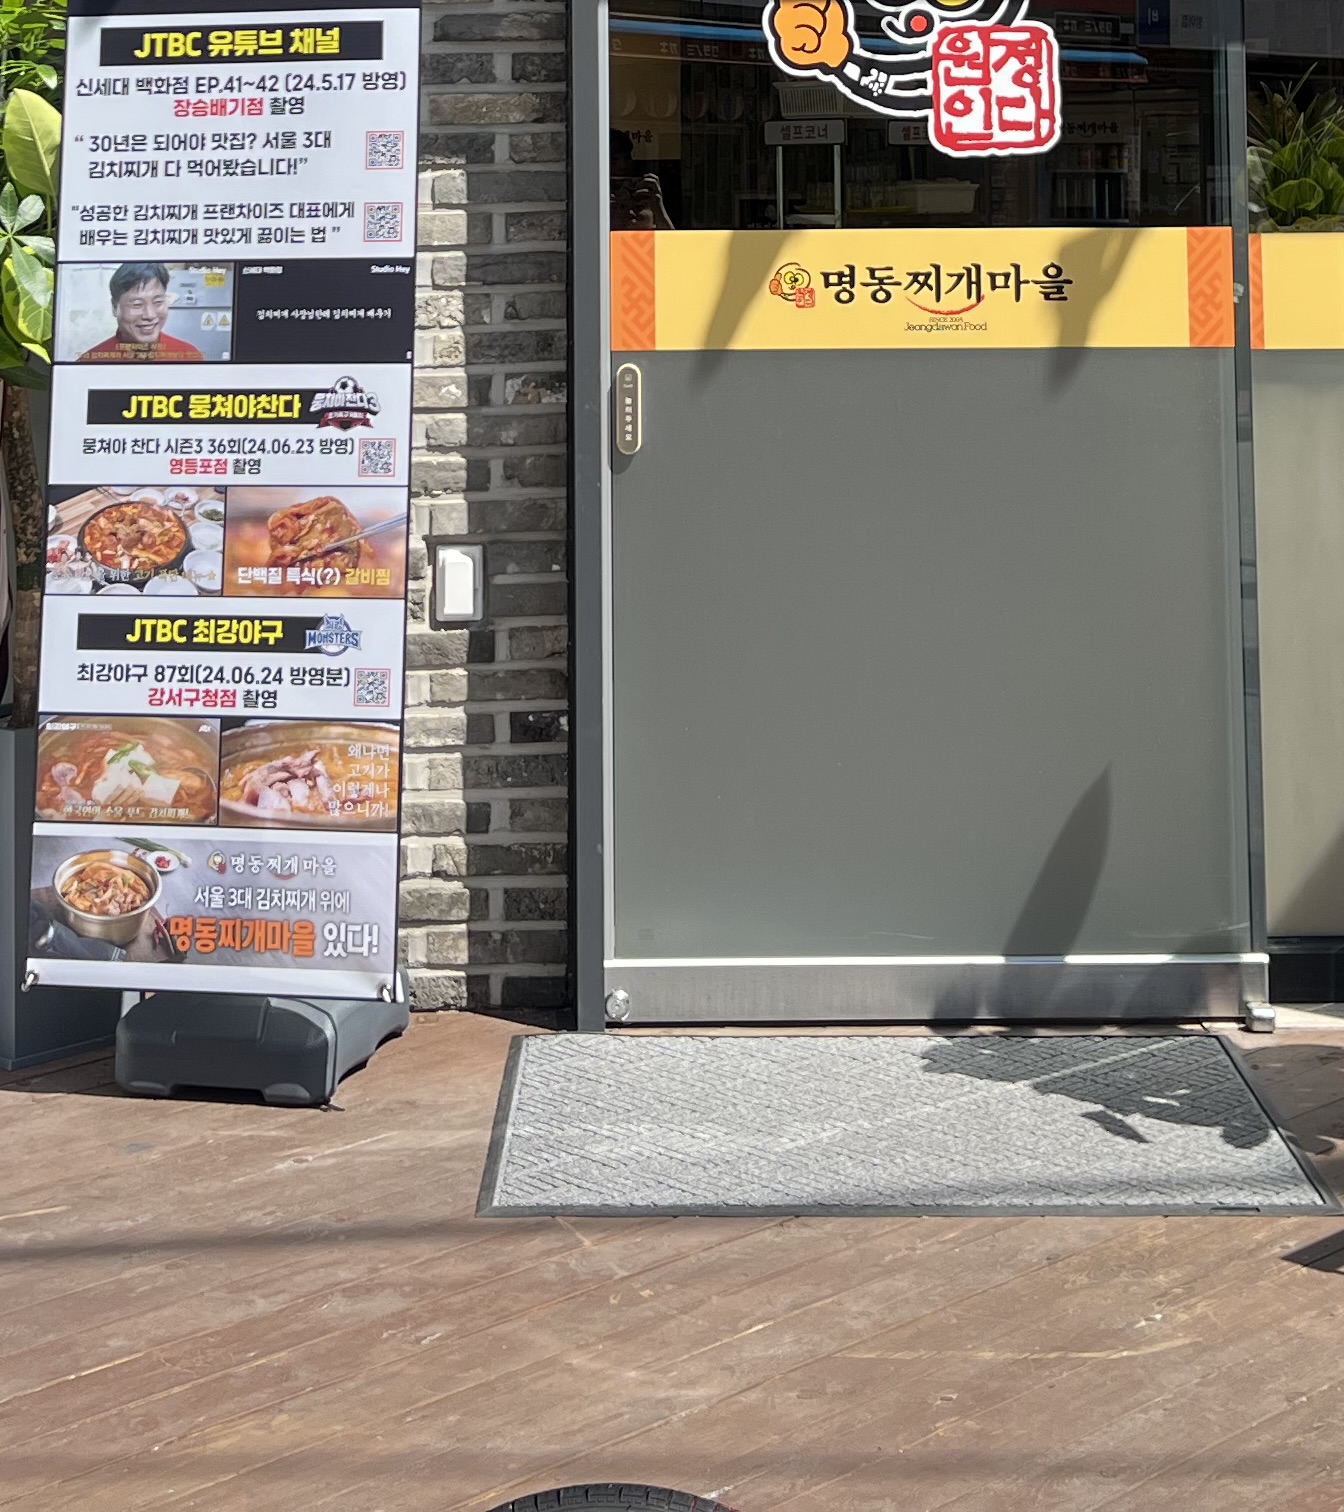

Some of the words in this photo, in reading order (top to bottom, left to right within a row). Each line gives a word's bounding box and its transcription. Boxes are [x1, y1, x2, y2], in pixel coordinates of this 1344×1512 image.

[134, 33, 202, 58] JTBC
[208, 29, 284, 56] 유튜브
[291, 27, 341, 54] 채널
[76, 76, 130, 96] 신세대
[136, 75, 189, 95] 백화점
[173, 98, 264, 117] 장승배기점
[269, 96, 305, 115] 촬영
[153, 132, 206, 152] 되어야
[211, 131, 257, 151] 맛집?
[262, 130, 299, 150] 서울
[303, 129, 332, 149] 3대
[779, 123, 829, 141] 셀프코너
[88, 159, 158, 179] 김치찌개
[164, 159, 181, 178] 다
[134, 203, 199, 222] 김치찌개
[203, 201, 284, 220] 프랜차이즈
[289, 201, 355, 219] 대표에게
[80, 228, 128, 246] 배우는
[134, 227, 199, 246] 김치찌개
[203, 227, 252, 246] 맛있게
[257, 226, 306, 245] 끓이는
[820, 262, 1074, 304] 명동찌개마을
[122, 396, 183, 419] JTBC
[188, 394, 301, 420] 뭉쳐야찬다
[82, 439, 127, 455] 뭉쳐야
[130, 438, 161, 454] 찬다
[165, 438, 204, 454] 시즌3
[169, 459, 228, 475] 영등포점
[232, 458, 262, 475] 촬영
[125, 619, 187, 643] JTBC
[192, 619, 284, 646] 최강야구
[307, 631, 360, 647] MONSTERS
[77, 663, 149, 684] 최강야구
[148, 688, 237, 709] 강서구청점
[242, 690, 278, 710] 촬영
[349, 762, 390, 780] 고기가
[332, 781, 390, 799] 이렇게나
[231, 854, 336, 875] 명동찌개마을
[194, 887, 225, 909] 서울
[228, 888, 252, 910] 3대
[256, 889, 316, 911] 김치찌개
[320, 890, 350, 912] 위에
[169, 916, 317, 957] 명동찌개마을
[323, 921, 379, 958] 있다!
